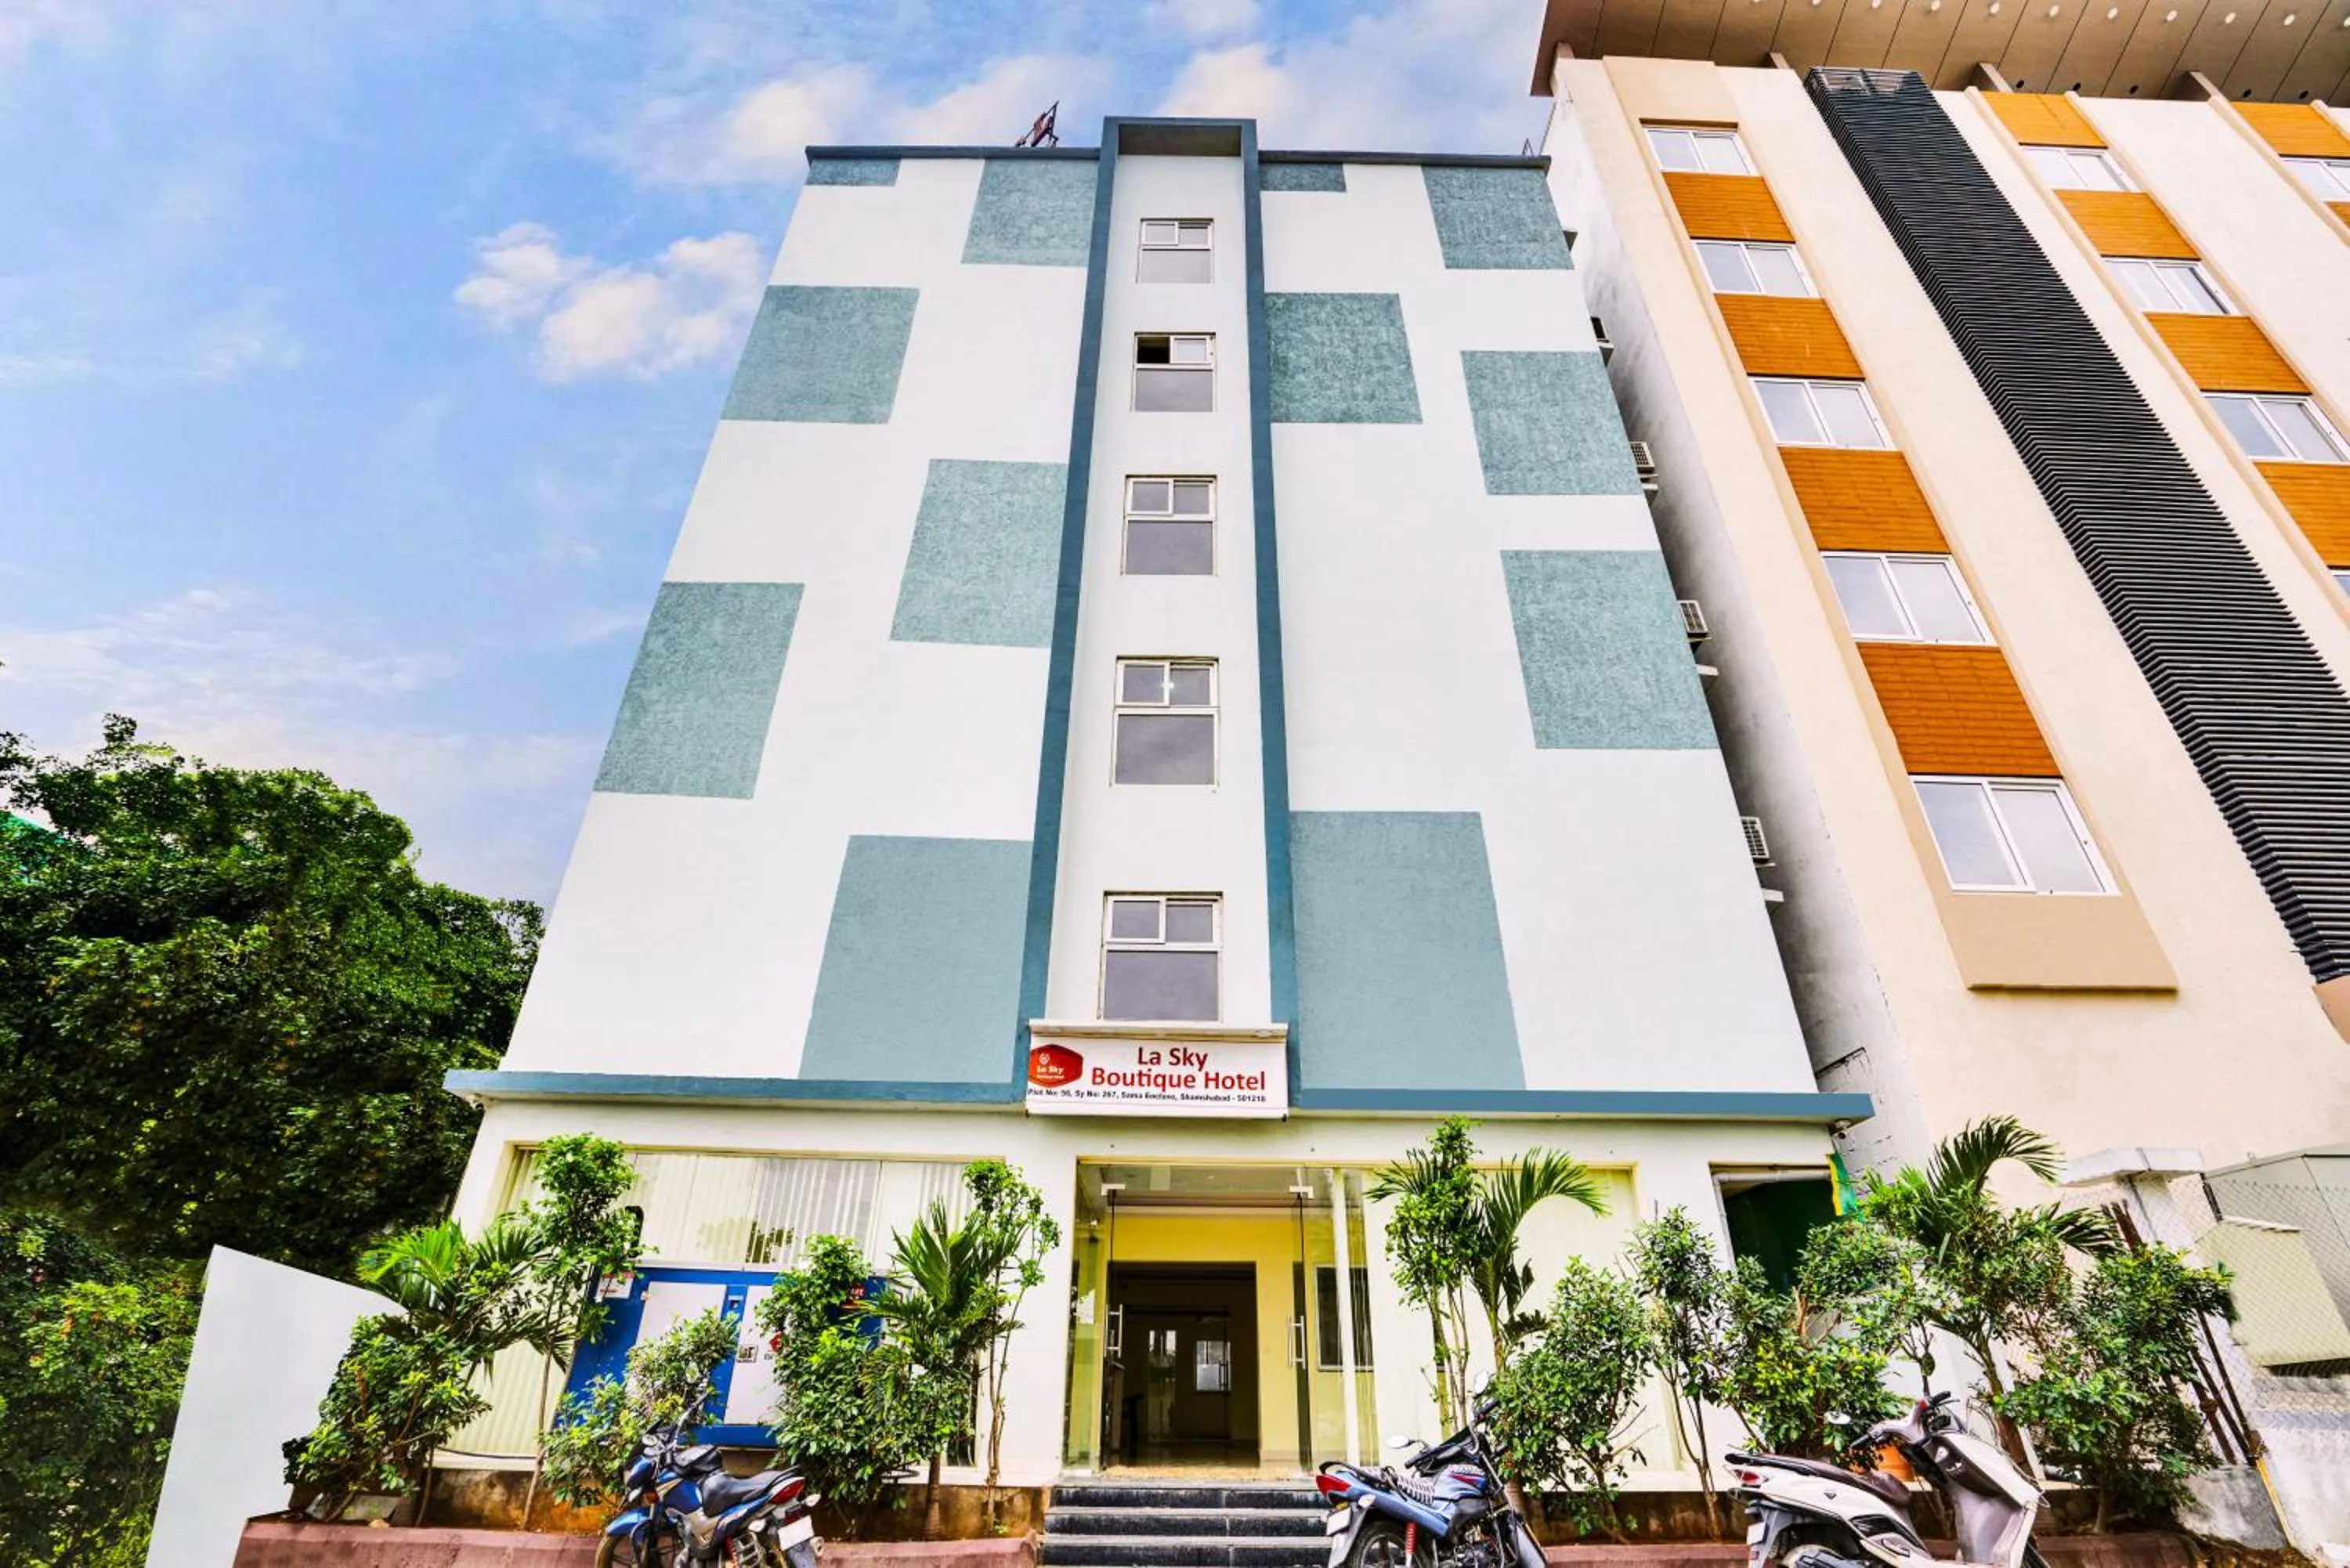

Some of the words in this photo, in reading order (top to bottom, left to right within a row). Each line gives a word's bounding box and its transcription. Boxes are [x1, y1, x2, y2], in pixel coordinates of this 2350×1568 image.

[1138, 1047, 1161, 1065] La
[1169, 1048, 1208, 1071] Sky
[1092, 1068, 1196, 1092] Boutique
[1204, 1071, 1265, 1090] Hotel
